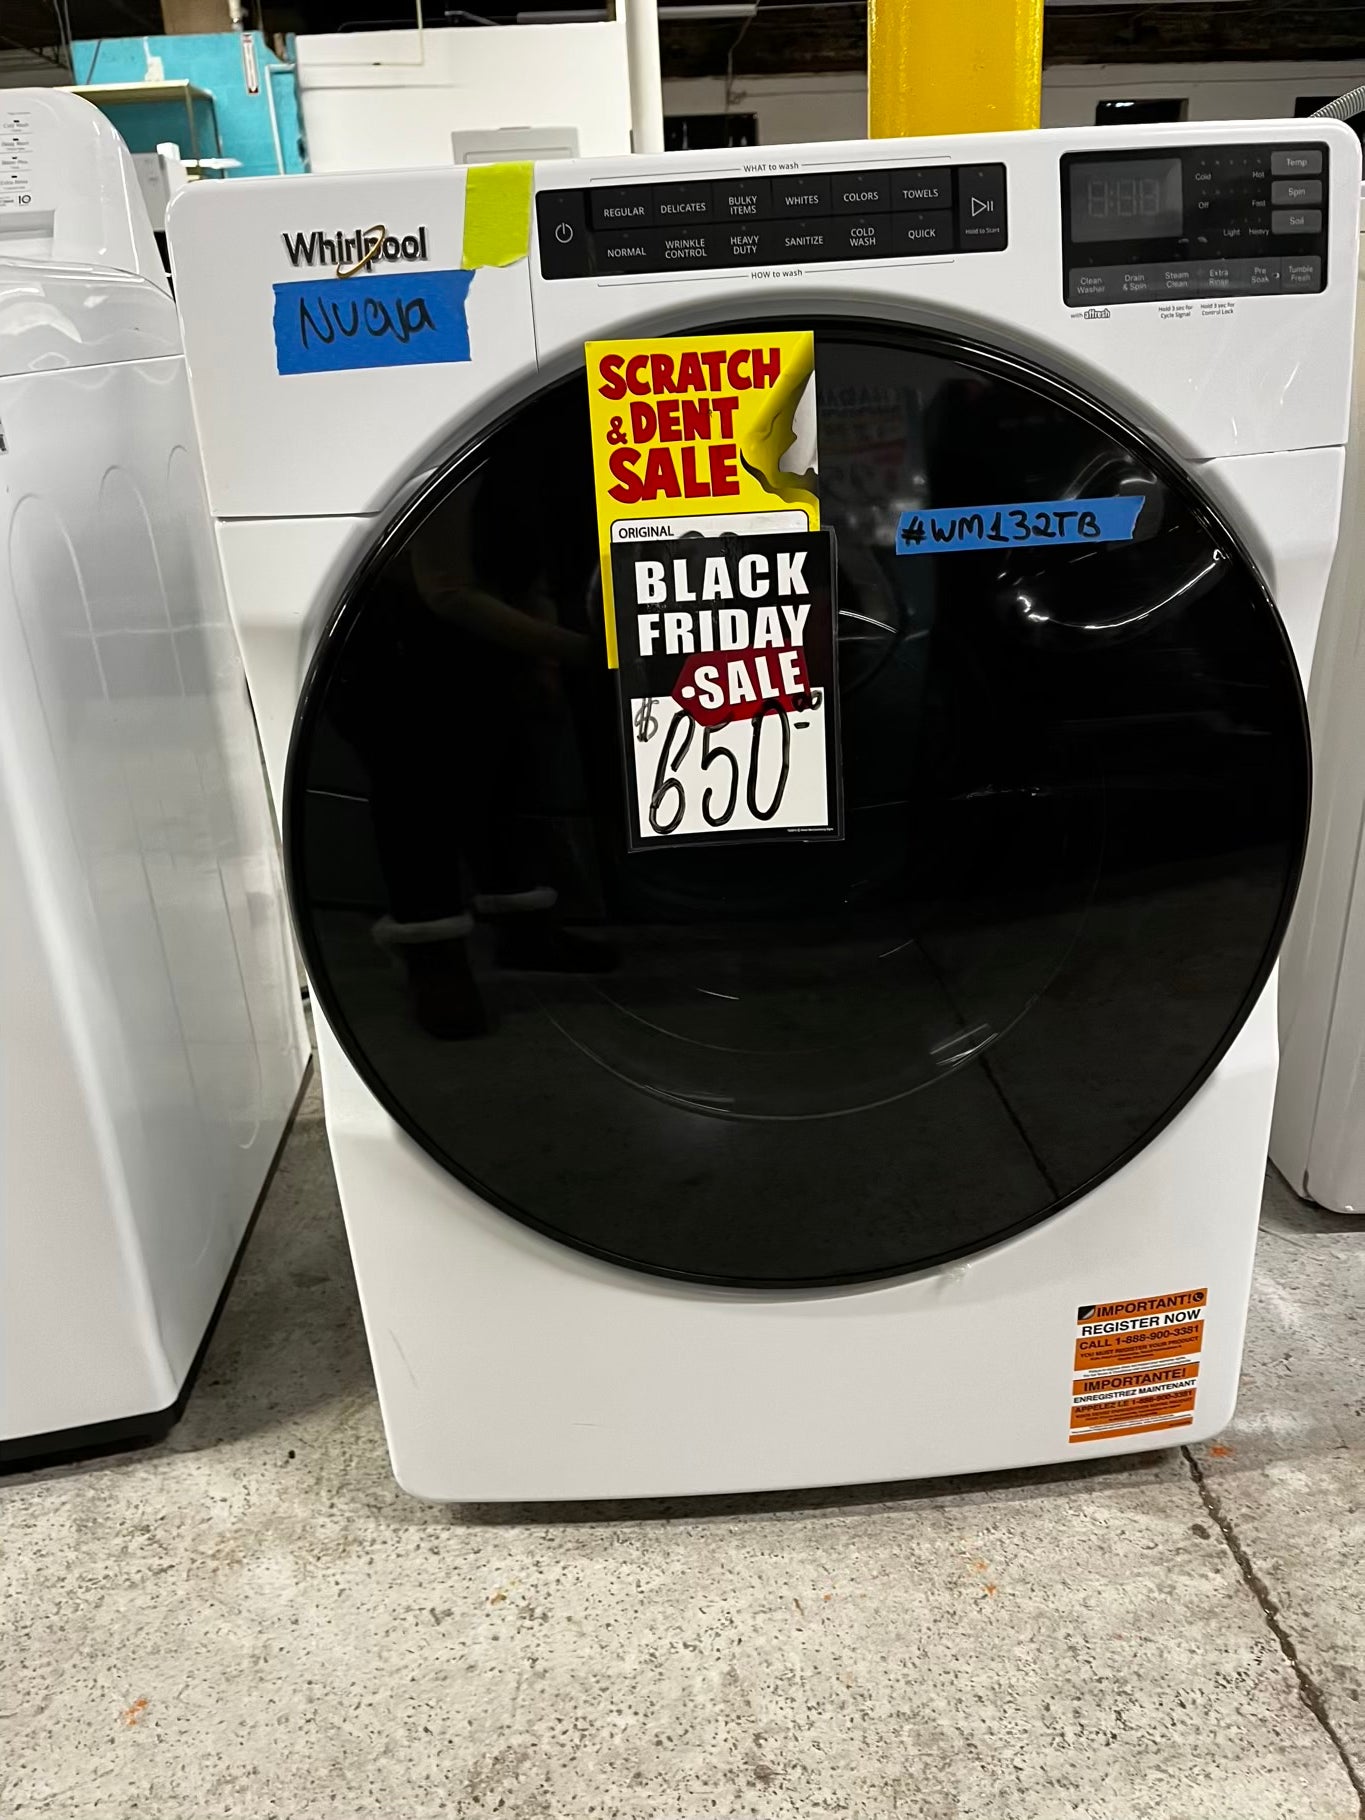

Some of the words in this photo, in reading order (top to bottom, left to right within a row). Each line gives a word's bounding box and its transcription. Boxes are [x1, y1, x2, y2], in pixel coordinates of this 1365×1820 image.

[743, 164, 766, 172] WHAT
[779, 162, 799, 170] wash
[1286, 158, 1307, 167] Temp
[843, 192, 879, 202] COLORS
[903, 189, 939, 199] TOWELS
[1288, 188, 1306, 198] Spin
[728, 196, 757, 206] BULKY
[785, 195, 819, 205] WHITES
[1198, 201, 1209, 209] Off
[604, 206, 645, 218] REGULAR
[660, 202, 706, 214] DELICATES
[730, 205, 757, 215] ITEMS
[1289, 216, 1304, 225] Soil
[850, 228, 875, 238] COLD
[908, 229, 936, 239] QUICK
[1223, 229, 1240, 237] Light
[1249, 228, 1269, 236] Heavy
[665, 239, 705, 249] WRINKLE
[730, 236, 759, 245] HEAVY
[785, 236, 823, 246] SANITIZE
[850, 237, 876, 247] WASH
[282, 225, 428, 275] Whirlpool
[607, 248, 647, 258] NORMAL
[665, 248, 708, 259] CONTROL
[733, 245, 757, 255] DUTY
[751, 271, 770, 279] HOW
[783, 269, 802, 277] wash
[1209, 269, 1228, 277] Extra
[1289, 265, 1313, 273] Tumble
[1080, 277, 1102, 285] Clean
[1124, 274, 1145, 282] Drain
[1166, 280, 1188, 288] Clean
[598, 348, 781, 400] SCRATCH
[606, 416, 628, 445] &
[630, 396, 739, 444] DENT
[608, 444, 740, 503] SALE
[618, 525, 674, 539] ORIGINAL
[902, 510, 1100, 546] #WM132TB
[635, 552, 809, 605] BLACK
[637, 604, 811, 656] FRIDAY
[694, 650, 805, 709] SALE
[1097, 1294, 1191, 1317] IMPORTANT!
[1082, 1317, 1159, 1336] REGISTER
[1164, 1309, 1201, 1325] NOW
[1080, 1340, 1112, 1350] CALL
[1116, 1325, 1199, 1345] 1-888-900-3381
[1084, 1368, 1186, 1391] IMPORTANTE!
[1074, 1389, 1137, 1404] ENREGISTREZ
[1139, 1380, 1196, 1394] MAINTENANT
